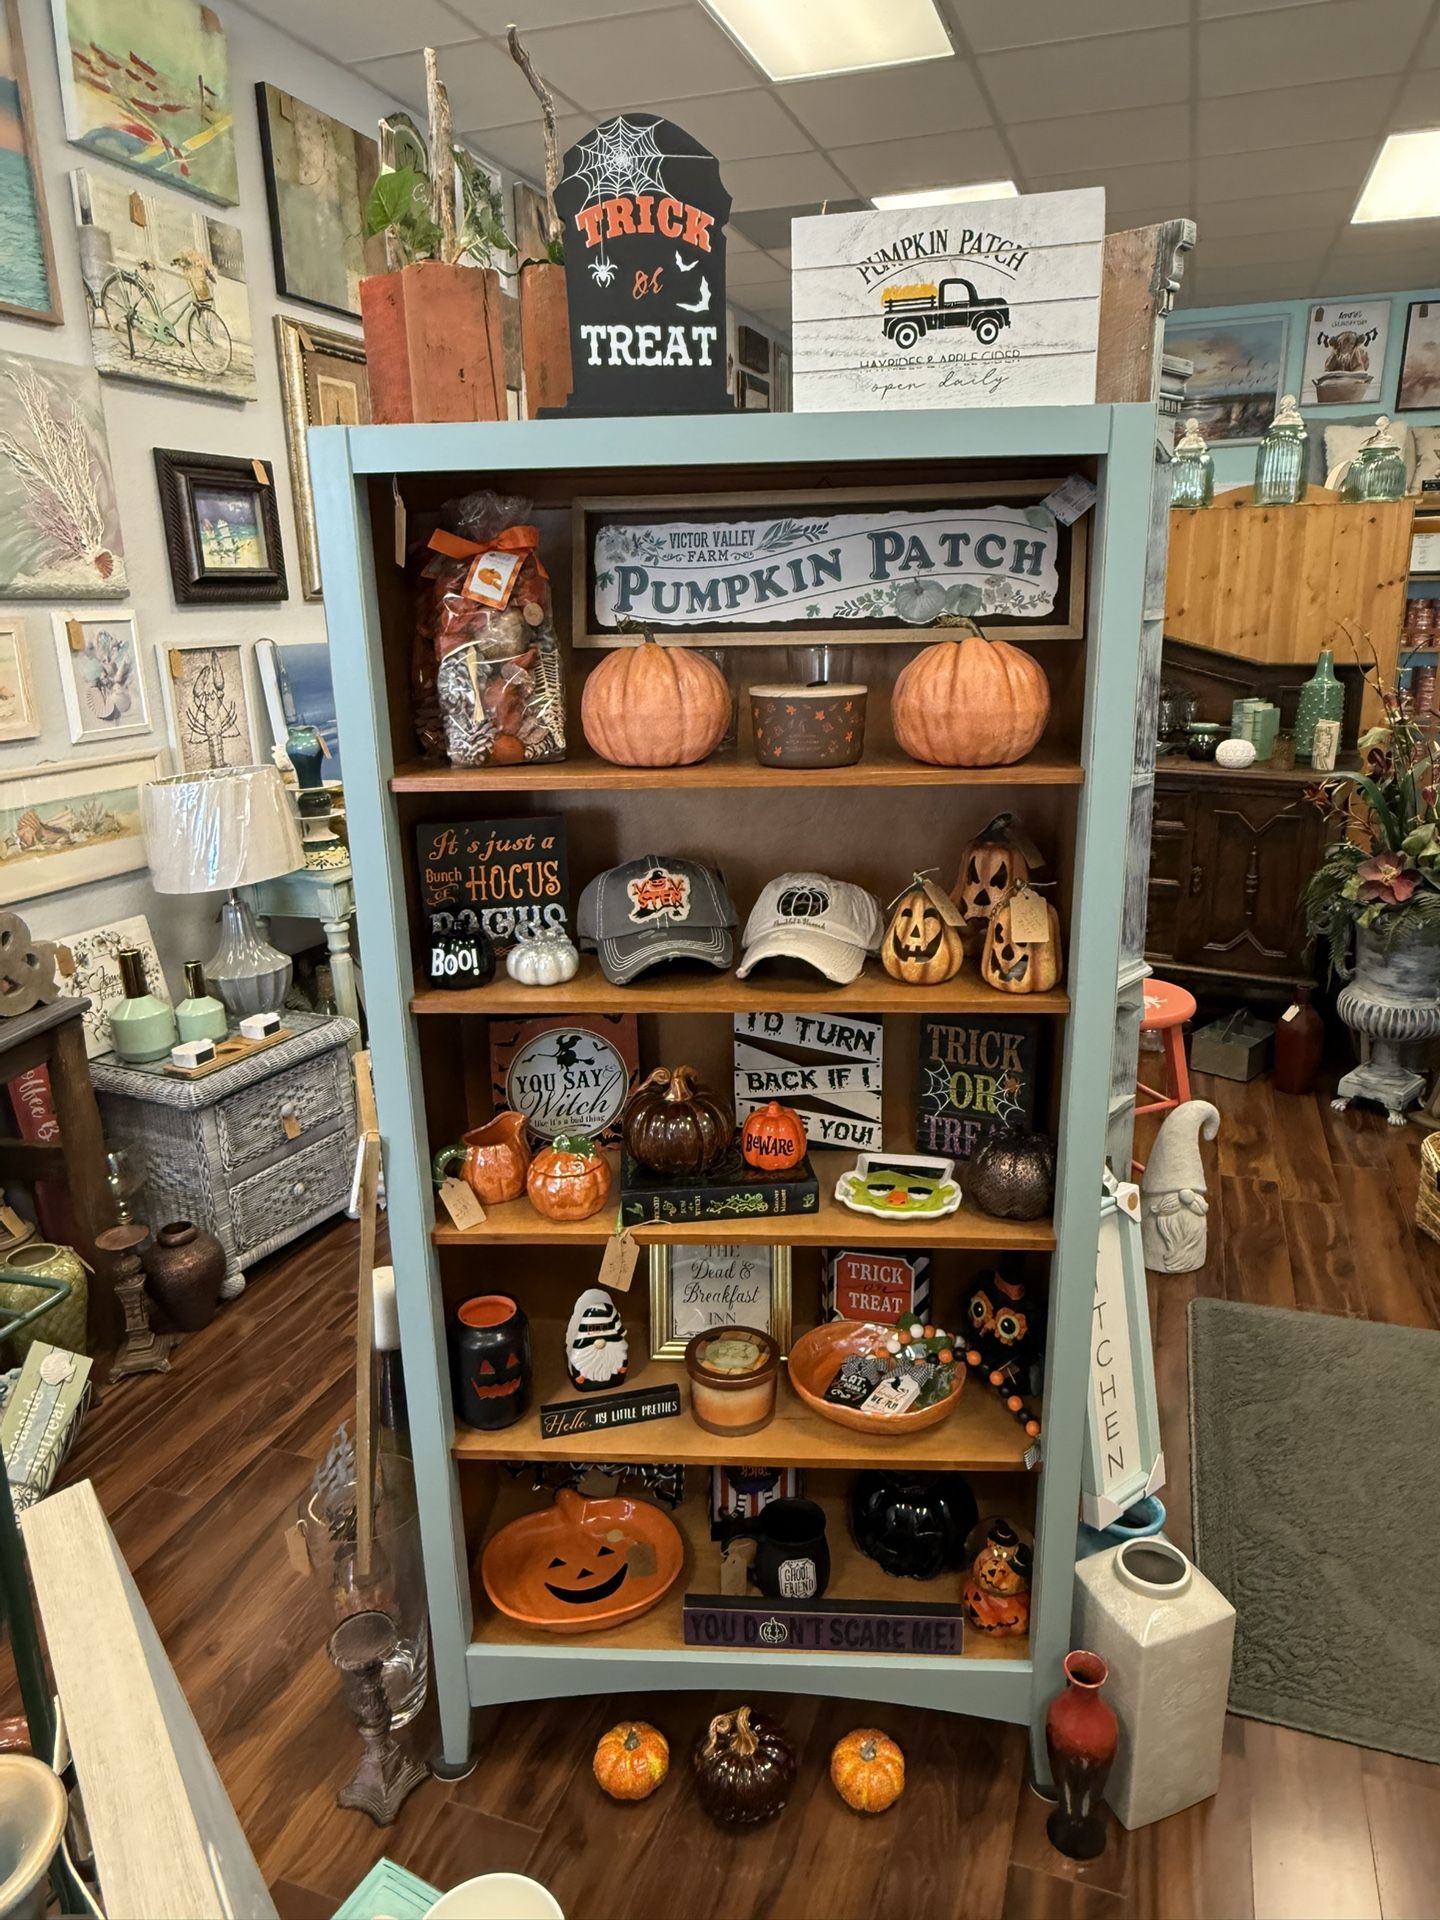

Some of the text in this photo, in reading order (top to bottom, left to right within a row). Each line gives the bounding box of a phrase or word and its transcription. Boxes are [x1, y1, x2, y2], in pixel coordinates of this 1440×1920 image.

[575, 196, 714, 252] TRICK
[856, 229, 1029, 285] PUMPKIN PATCH
[581, 325, 717, 366] TREAT
[871, 368, 1009, 400] open daily
[669, 529, 755, 549] VICTOR VALLEY
[613, 530, 1047, 614] PUMPKIN PATCH
[687, 550, 729, 563] FARM
[428, 828, 556, 861] It's just a
[425, 860, 562, 901] Bunch HOCUS
[795, 1016, 876, 1055] TURN
[927, 1023, 1025, 1073] TRICK
[19, 1070, 47, 1118] offee
[516, 1069, 603, 1094] YOU SAY
[519, 1070, 623, 1119] Witch
[745, 1067, 870, 1092] BACK IF I
[950, 1071, 998, 1114] OR
[820, 1119, 874, 1146] YOU!
[924, 1114, 1002, 1155] TRE
[704, 1244, 741, 1258] THE
[691, 1258, 755, 1280] Dead &
[848, 1261, 904, 1285] TRICK
[683, 1281, 761, 1310] Breakfast
[848, 1291, 904, 1314] TREAT
[708, 1312, 737, 1325] INN
[1093, 1255, 1125, 1478] TCHEN
[595, 1411, 607, 1424] MY
[611, 1406, 637, 1422] LITTLE
[641, 1400, 678, 1416] PRETTIES
[691, 1613, 736, 1640] YOU
[829, 1618, 905, 1649] SCARE
[912, 1620, 956, 1650] ME!
